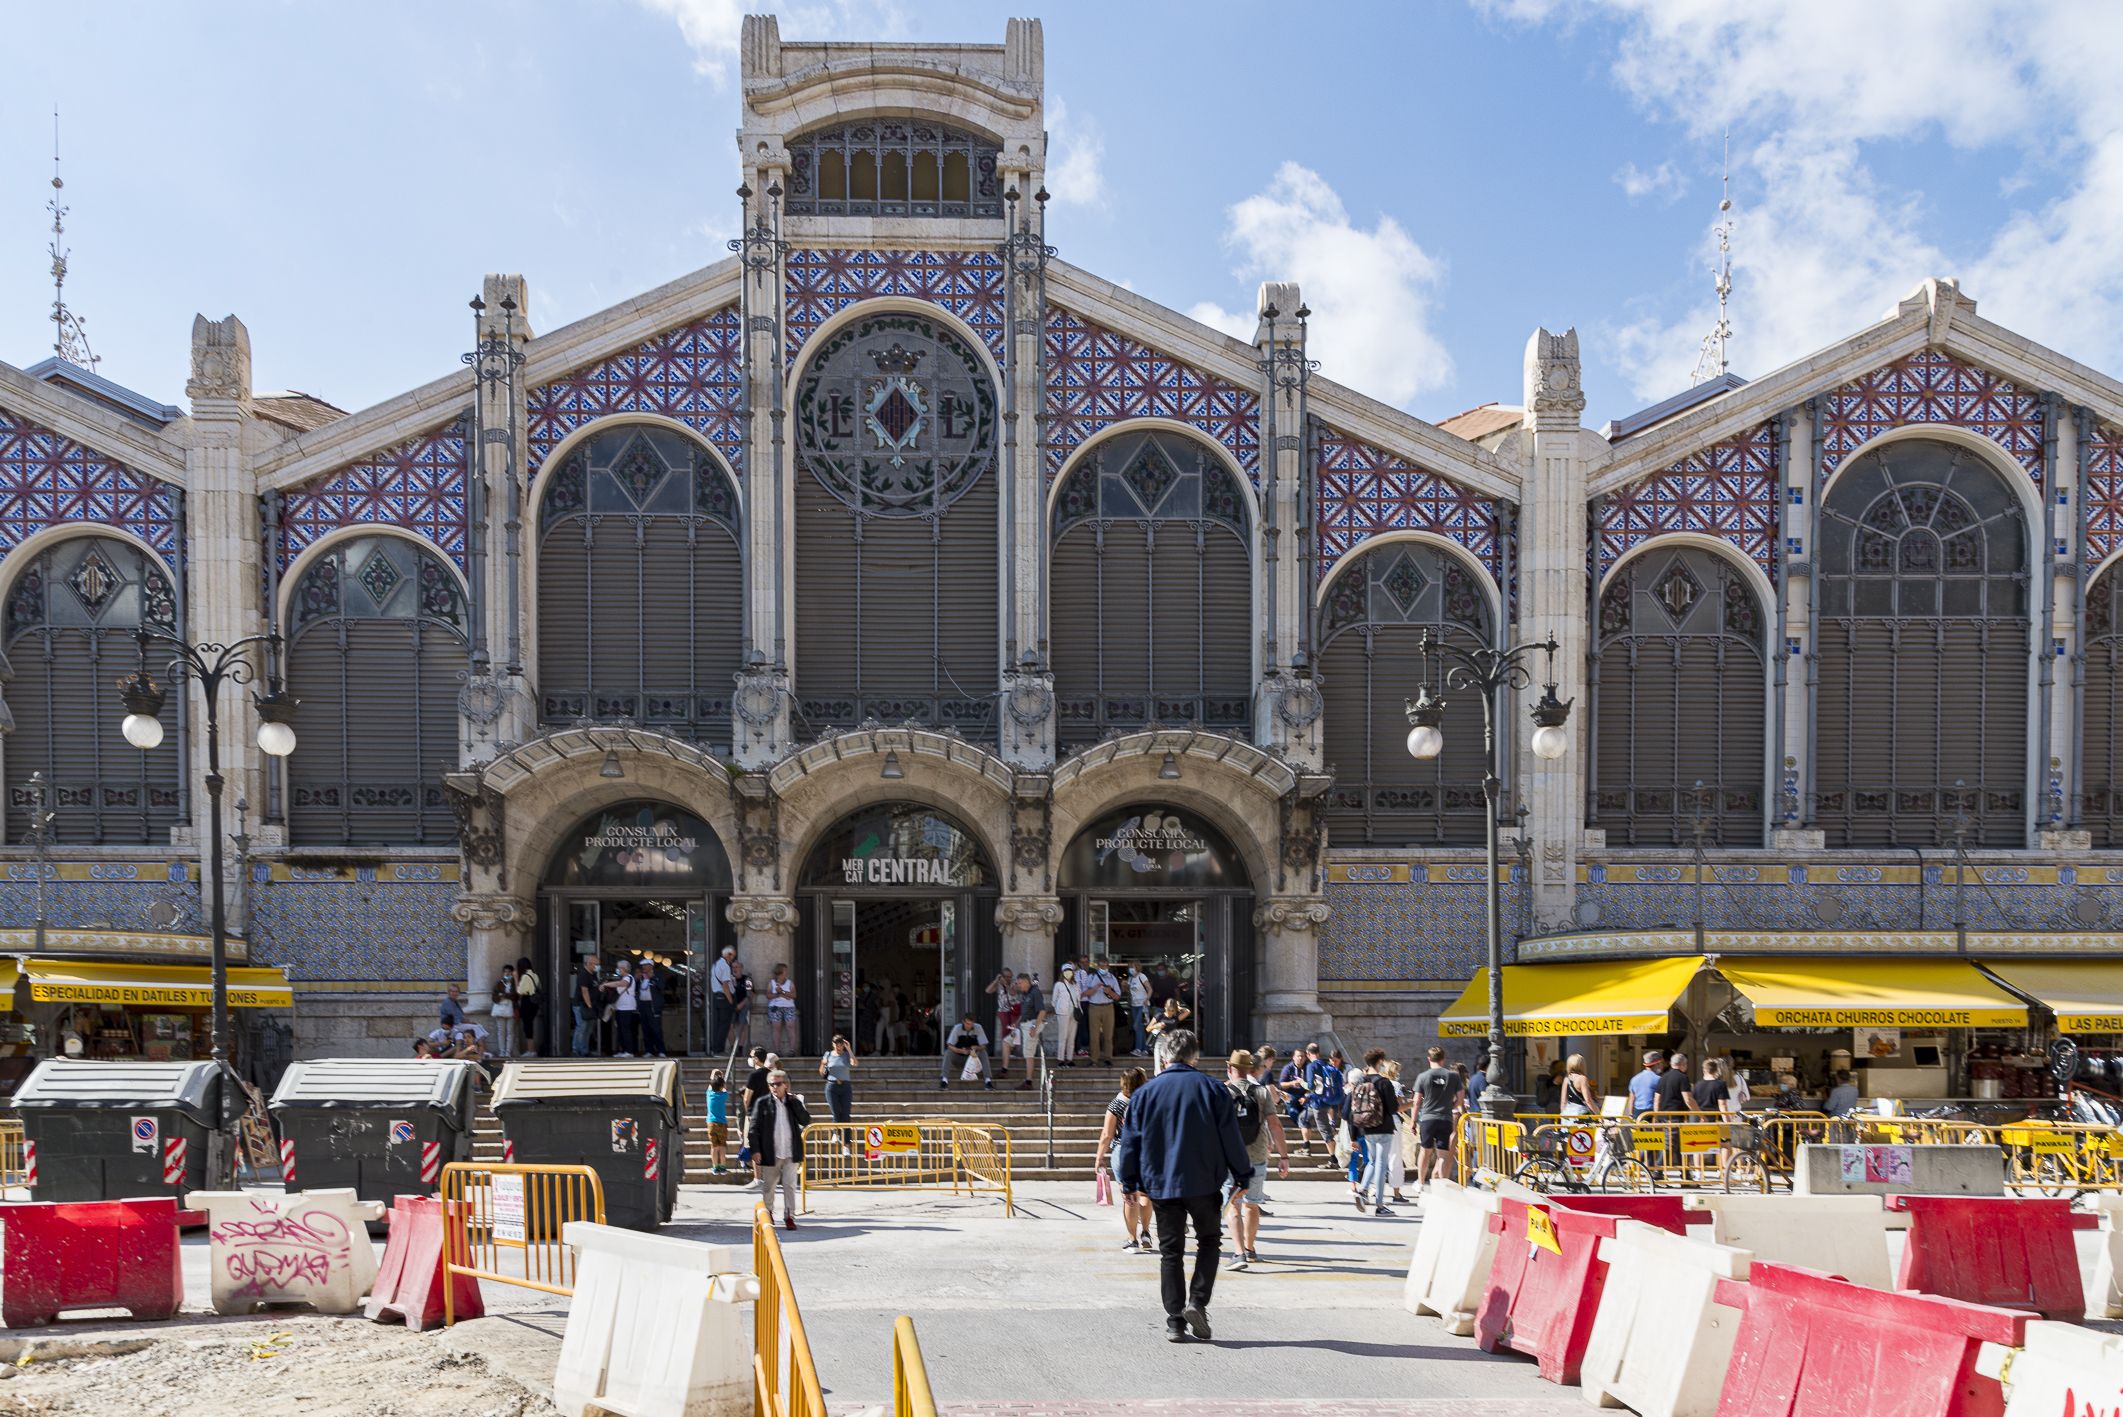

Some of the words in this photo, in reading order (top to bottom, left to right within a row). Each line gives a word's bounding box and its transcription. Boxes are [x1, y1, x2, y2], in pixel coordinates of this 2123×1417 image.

[606, 827, 678, 838] CONSUMIX
[1117, 828, 1187, 839] CONSUMIX
[585, 837, 654, 848] PRODUCTE
[656, 838, 700, 849] LOCAL
[1096, 838, 1164, 849] PRODUCTE
[1166, 839, 1209, 850] LOCAL
[842, 859, 864, 871] MER
[868, 858, 953, 883] CENTRAL
[845, 870, 864, 883] CAT
[33, 986, 120, 1001] ESPECIALIDAD
[124, 989, 139, 1001] EN
[142, 989, 188, 1003] DATILES
[191, 991, 198, 1001] Y
[200, 991, 257, 1004] TUONES
[1775, 1011, 1833, 1024] ORCHATA
[1836, 1011, 1895, 1024] CHURROS
[1898, 1011, 1970, 1025] CHOCOLATE
[1446, 1023, 1489, 1036] ORCHAT
[1503, 1020, 1551, 1035] HURROS
[1553, 1019, 1624, 1032] CHOCOLATE
[2069, 1018, 2092, 1031] LAS
[887, 1129, 914, 1138] DESVIO
